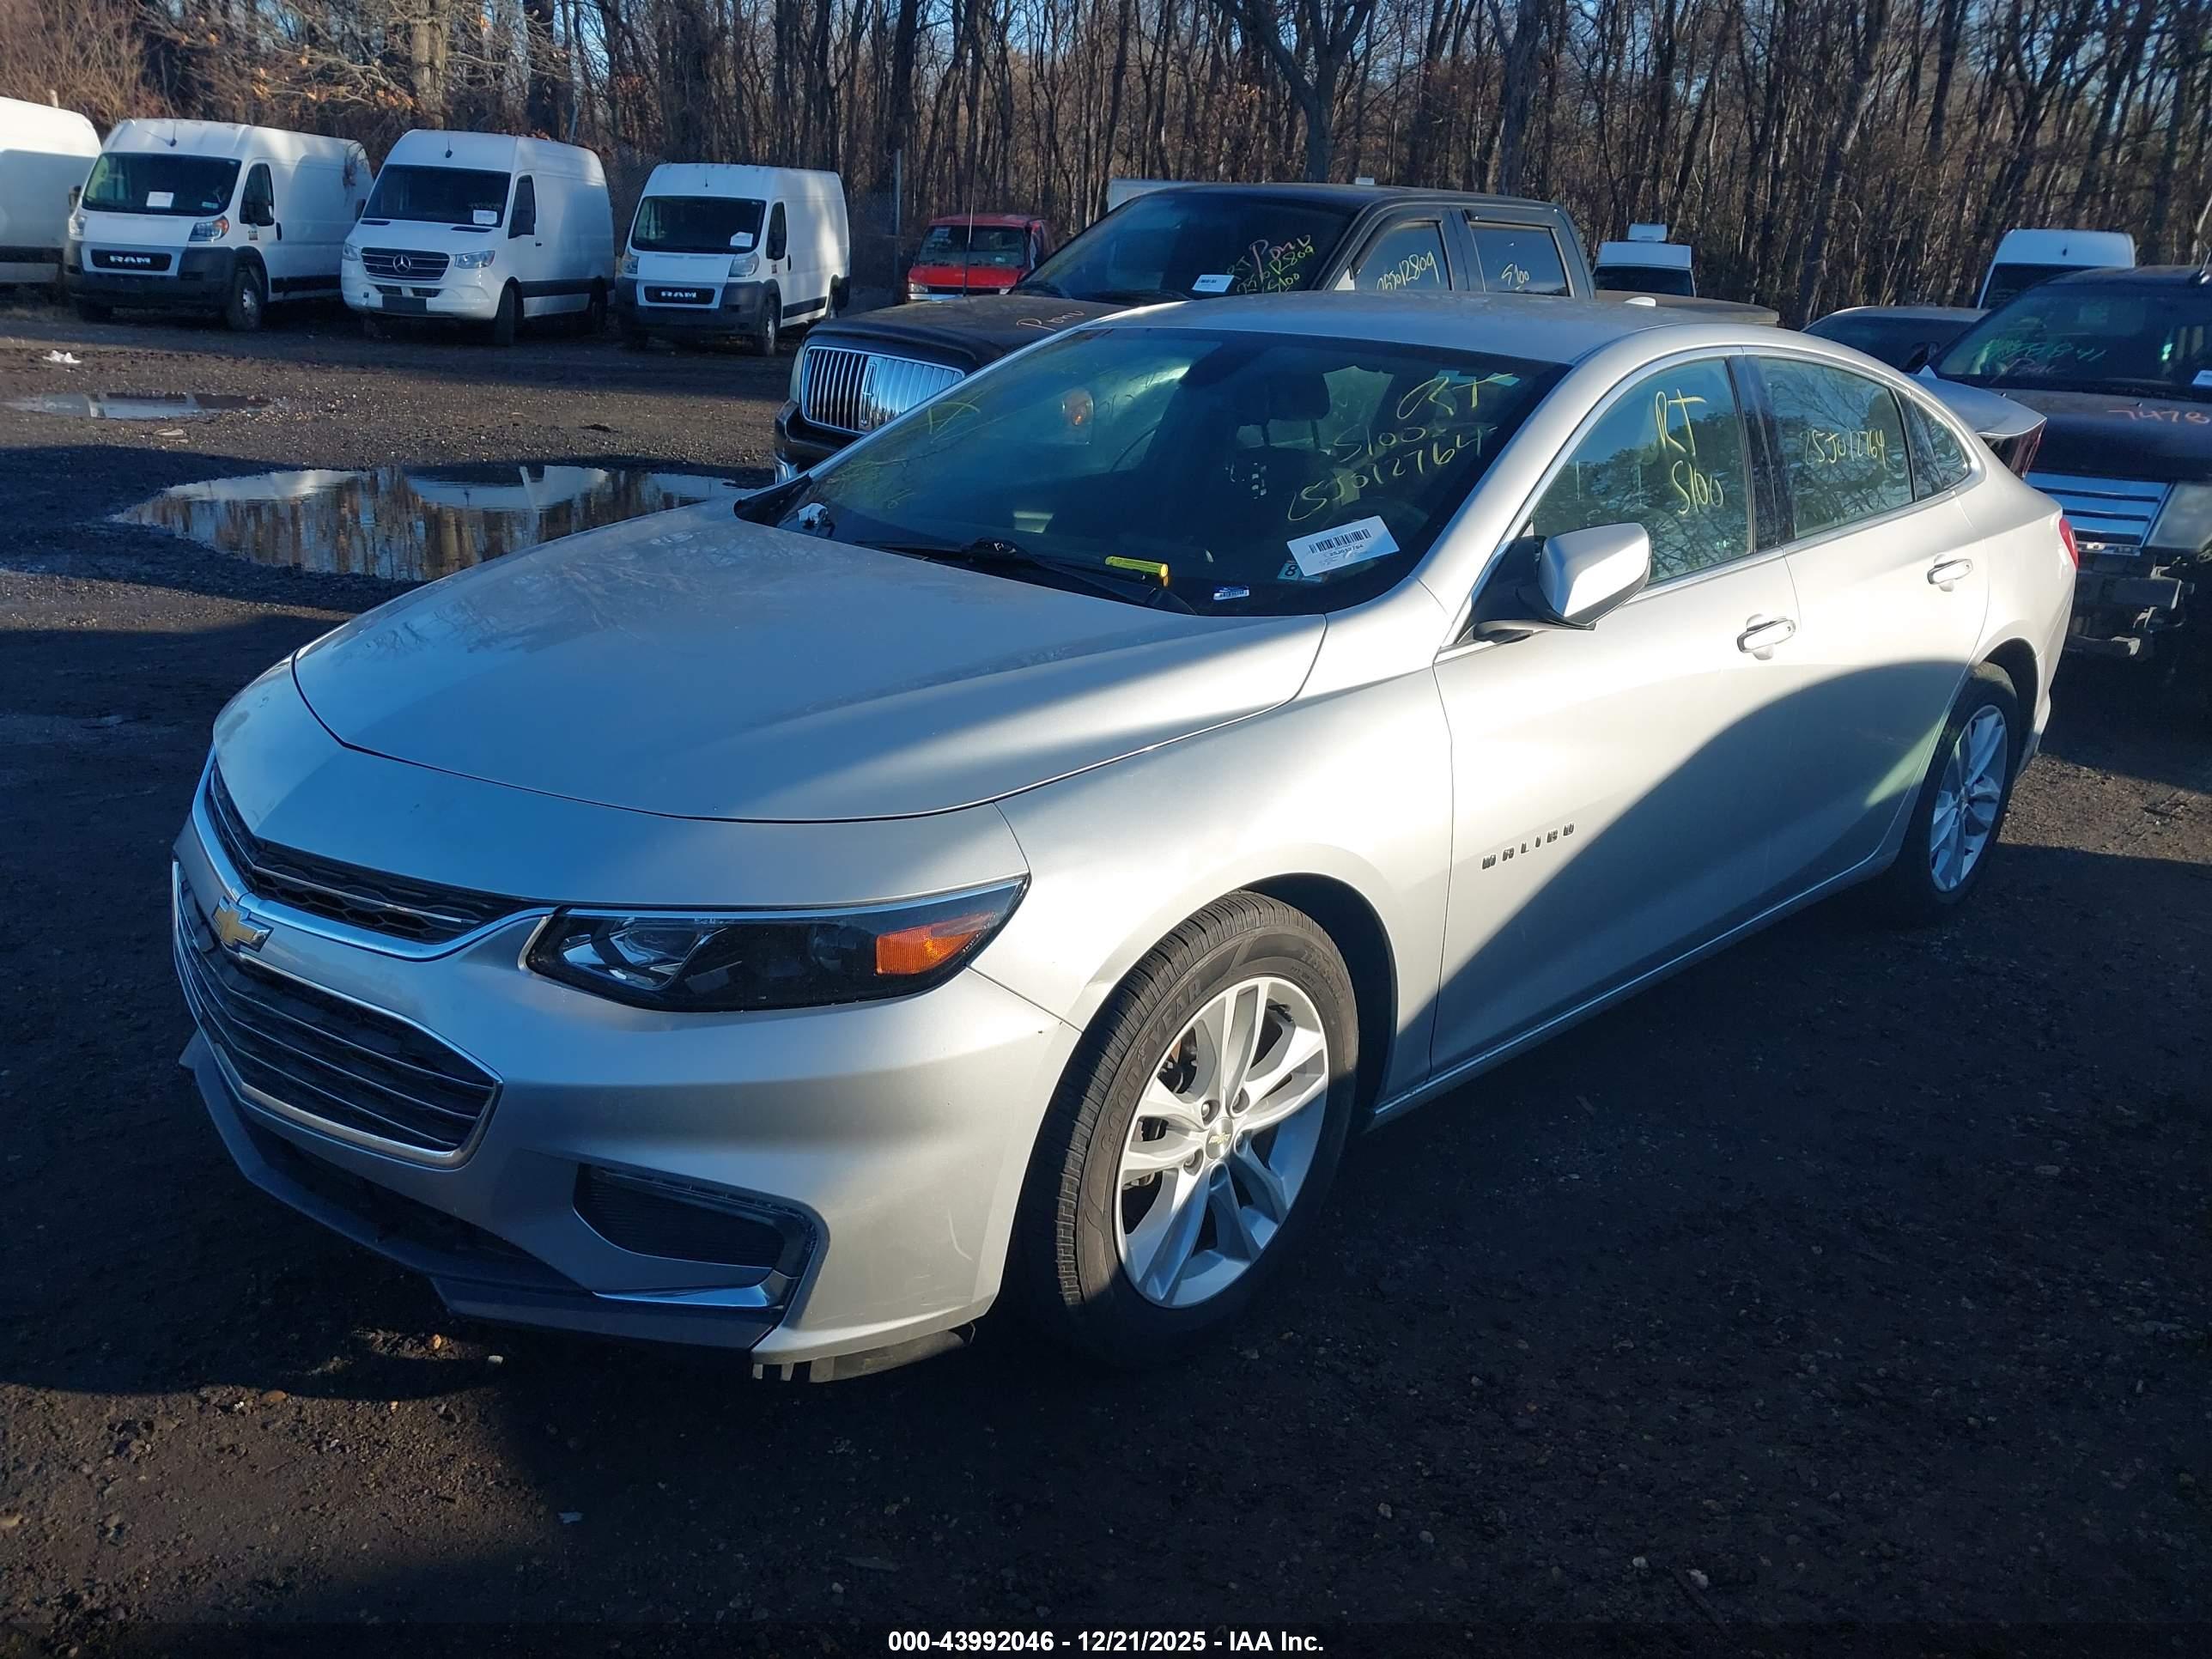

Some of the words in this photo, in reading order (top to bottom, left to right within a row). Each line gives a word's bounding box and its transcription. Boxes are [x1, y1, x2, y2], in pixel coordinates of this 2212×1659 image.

[109, 255, 151, 264] RAM
[660, 290, 697, 299] RAM
[1656, 388, 1707, 457] RT
[1285, 564, 1298, 578] 8
[1481, 822, 1575, 870] MALIBU
